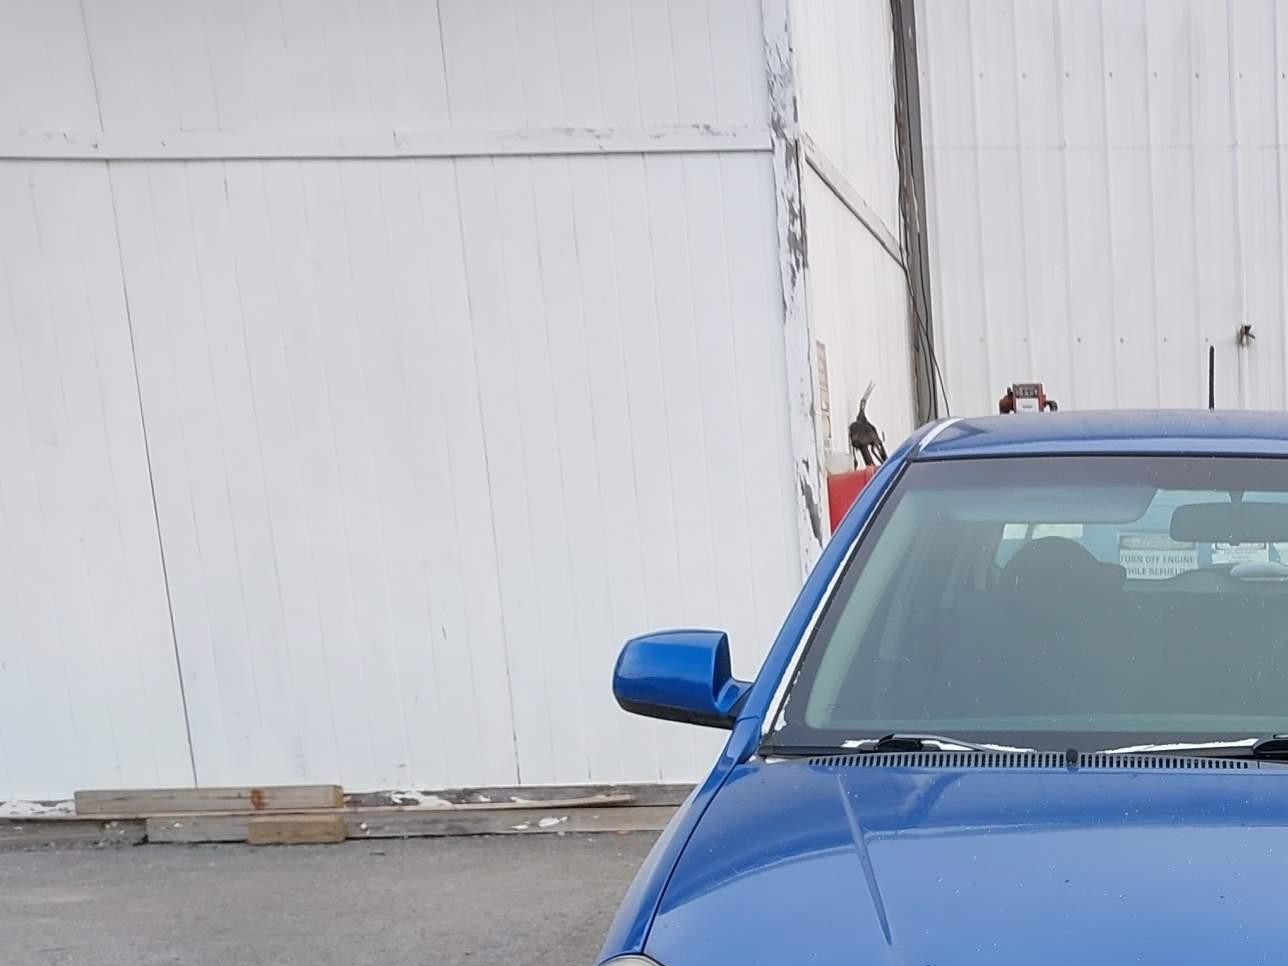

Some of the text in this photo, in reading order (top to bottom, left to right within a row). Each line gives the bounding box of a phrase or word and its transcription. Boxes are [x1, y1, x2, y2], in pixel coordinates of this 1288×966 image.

[1120, 555, 1193, 564] TURN OFF ENGINE
